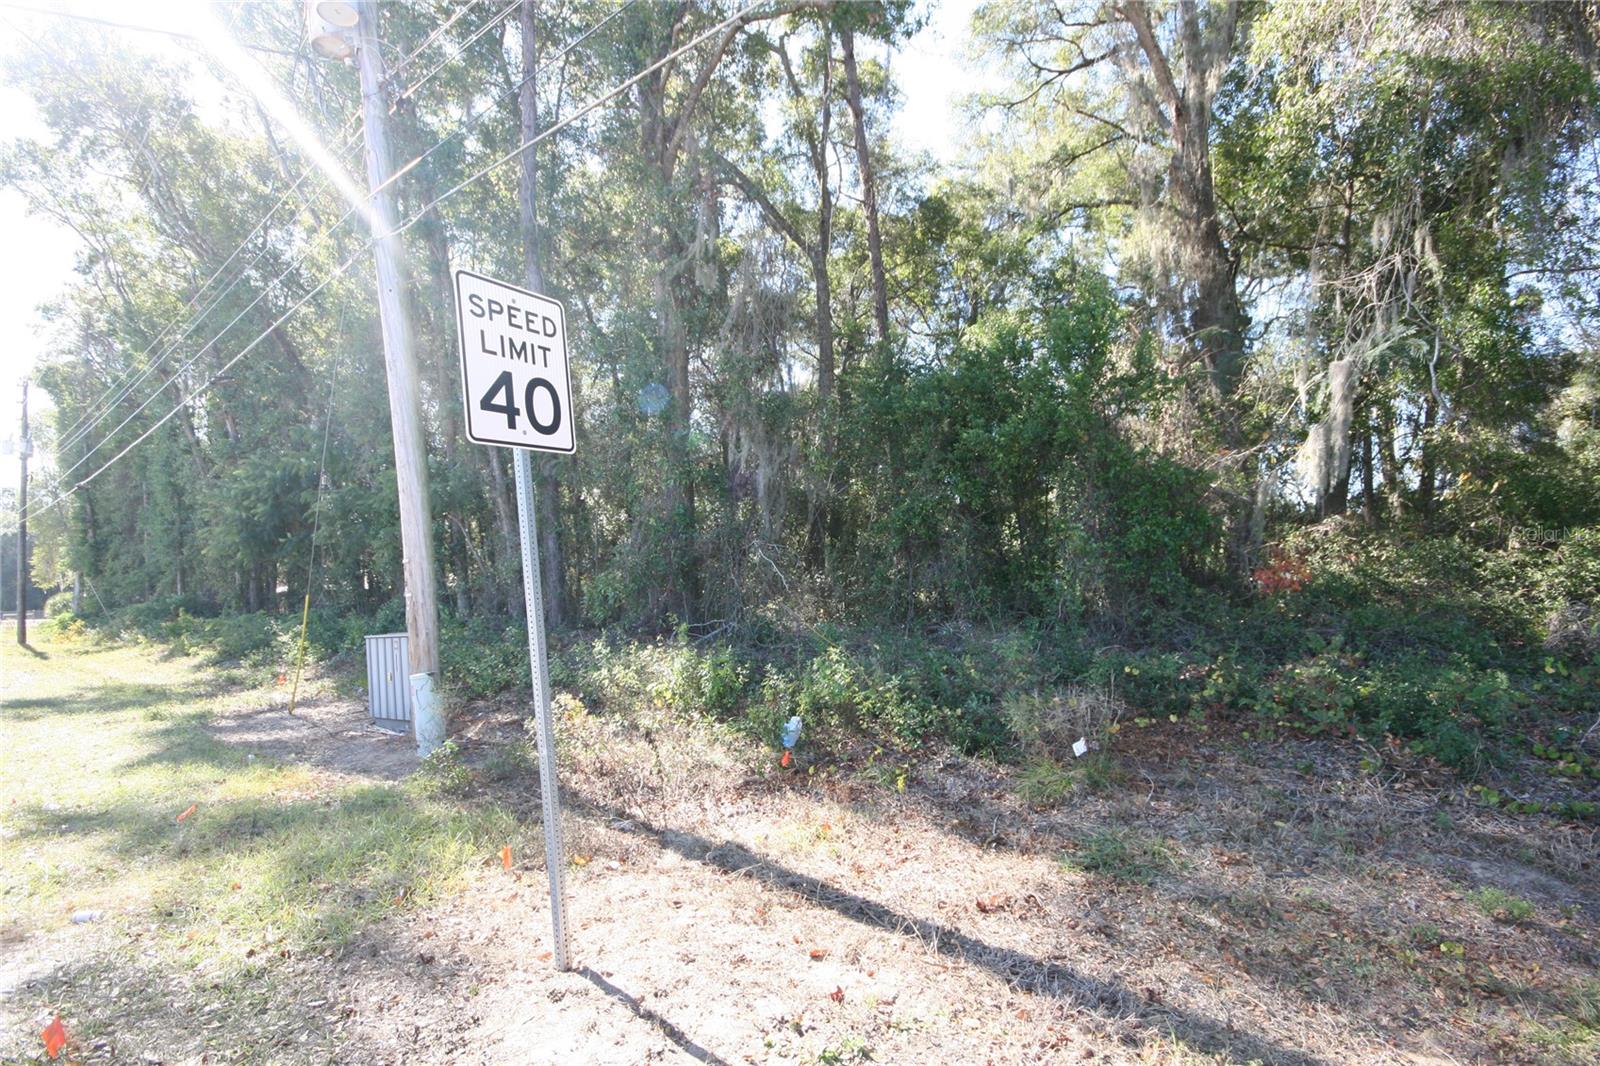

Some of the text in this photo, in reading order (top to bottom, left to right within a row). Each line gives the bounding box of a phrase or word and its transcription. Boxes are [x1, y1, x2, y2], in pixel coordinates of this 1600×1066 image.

[469, 294, 557, 338] SPEED
[480, 329, 551, 368] LIMIT
[480, 370, 562, 435] 40
